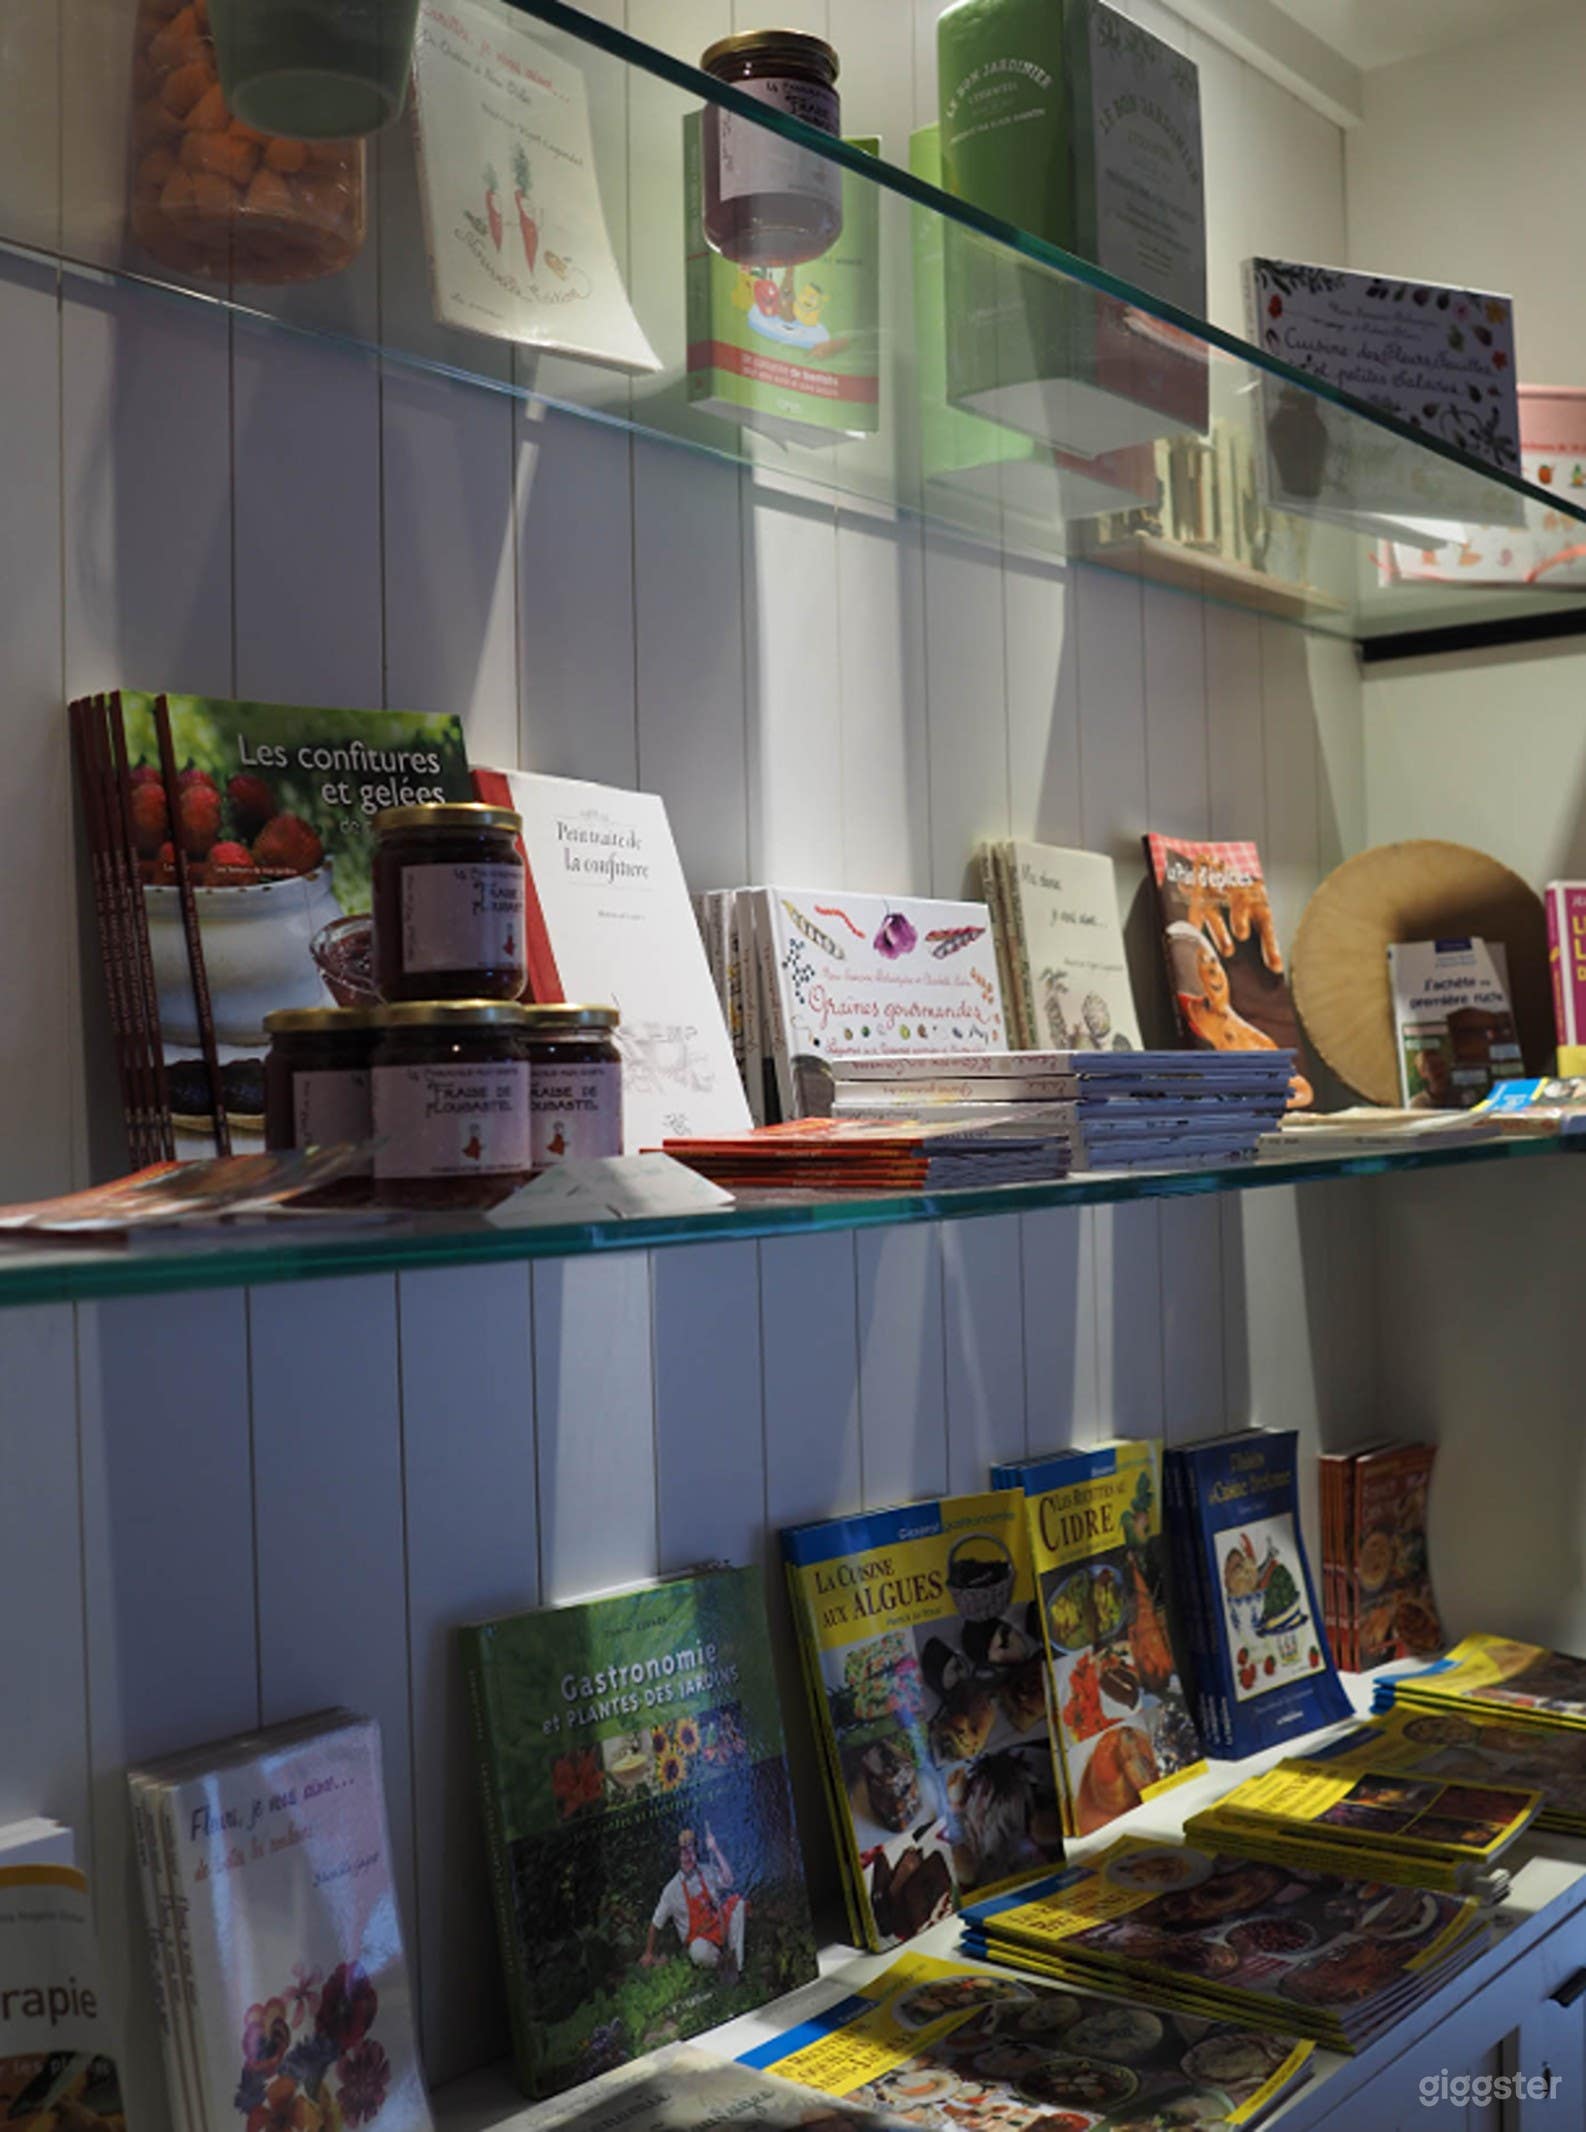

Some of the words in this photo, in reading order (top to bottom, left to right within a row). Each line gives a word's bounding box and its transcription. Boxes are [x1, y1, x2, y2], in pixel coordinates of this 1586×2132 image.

[982, 58, 1054, 91] JARDINIER
[238, 734, 288, 768] Les
[298, 740, 441, 774] confitures
[322, 781, 352, 805] et
[360, 777, 445, 815] gelées
[564, 847, 581, 872] la
[583, 851, 649, 885] confiture
[808, 984, 879, 1030] Graines
[882, 1000, 991, 1030] gourmandes
[531, 1084, 573, 1099] RAISE
[1039, 1497, 1114, 1551] CIDRE
[823, 1607, 849, 1629] AUX
[852, 1570, 944, 1620] ALGUES
[561, 1638, 719, 1701] Gastronomie
[542, 1713, 560, 1736] et
[565, 1691, 640, 1728] PLANTES
[644, 1681, 675, 1708] DES
